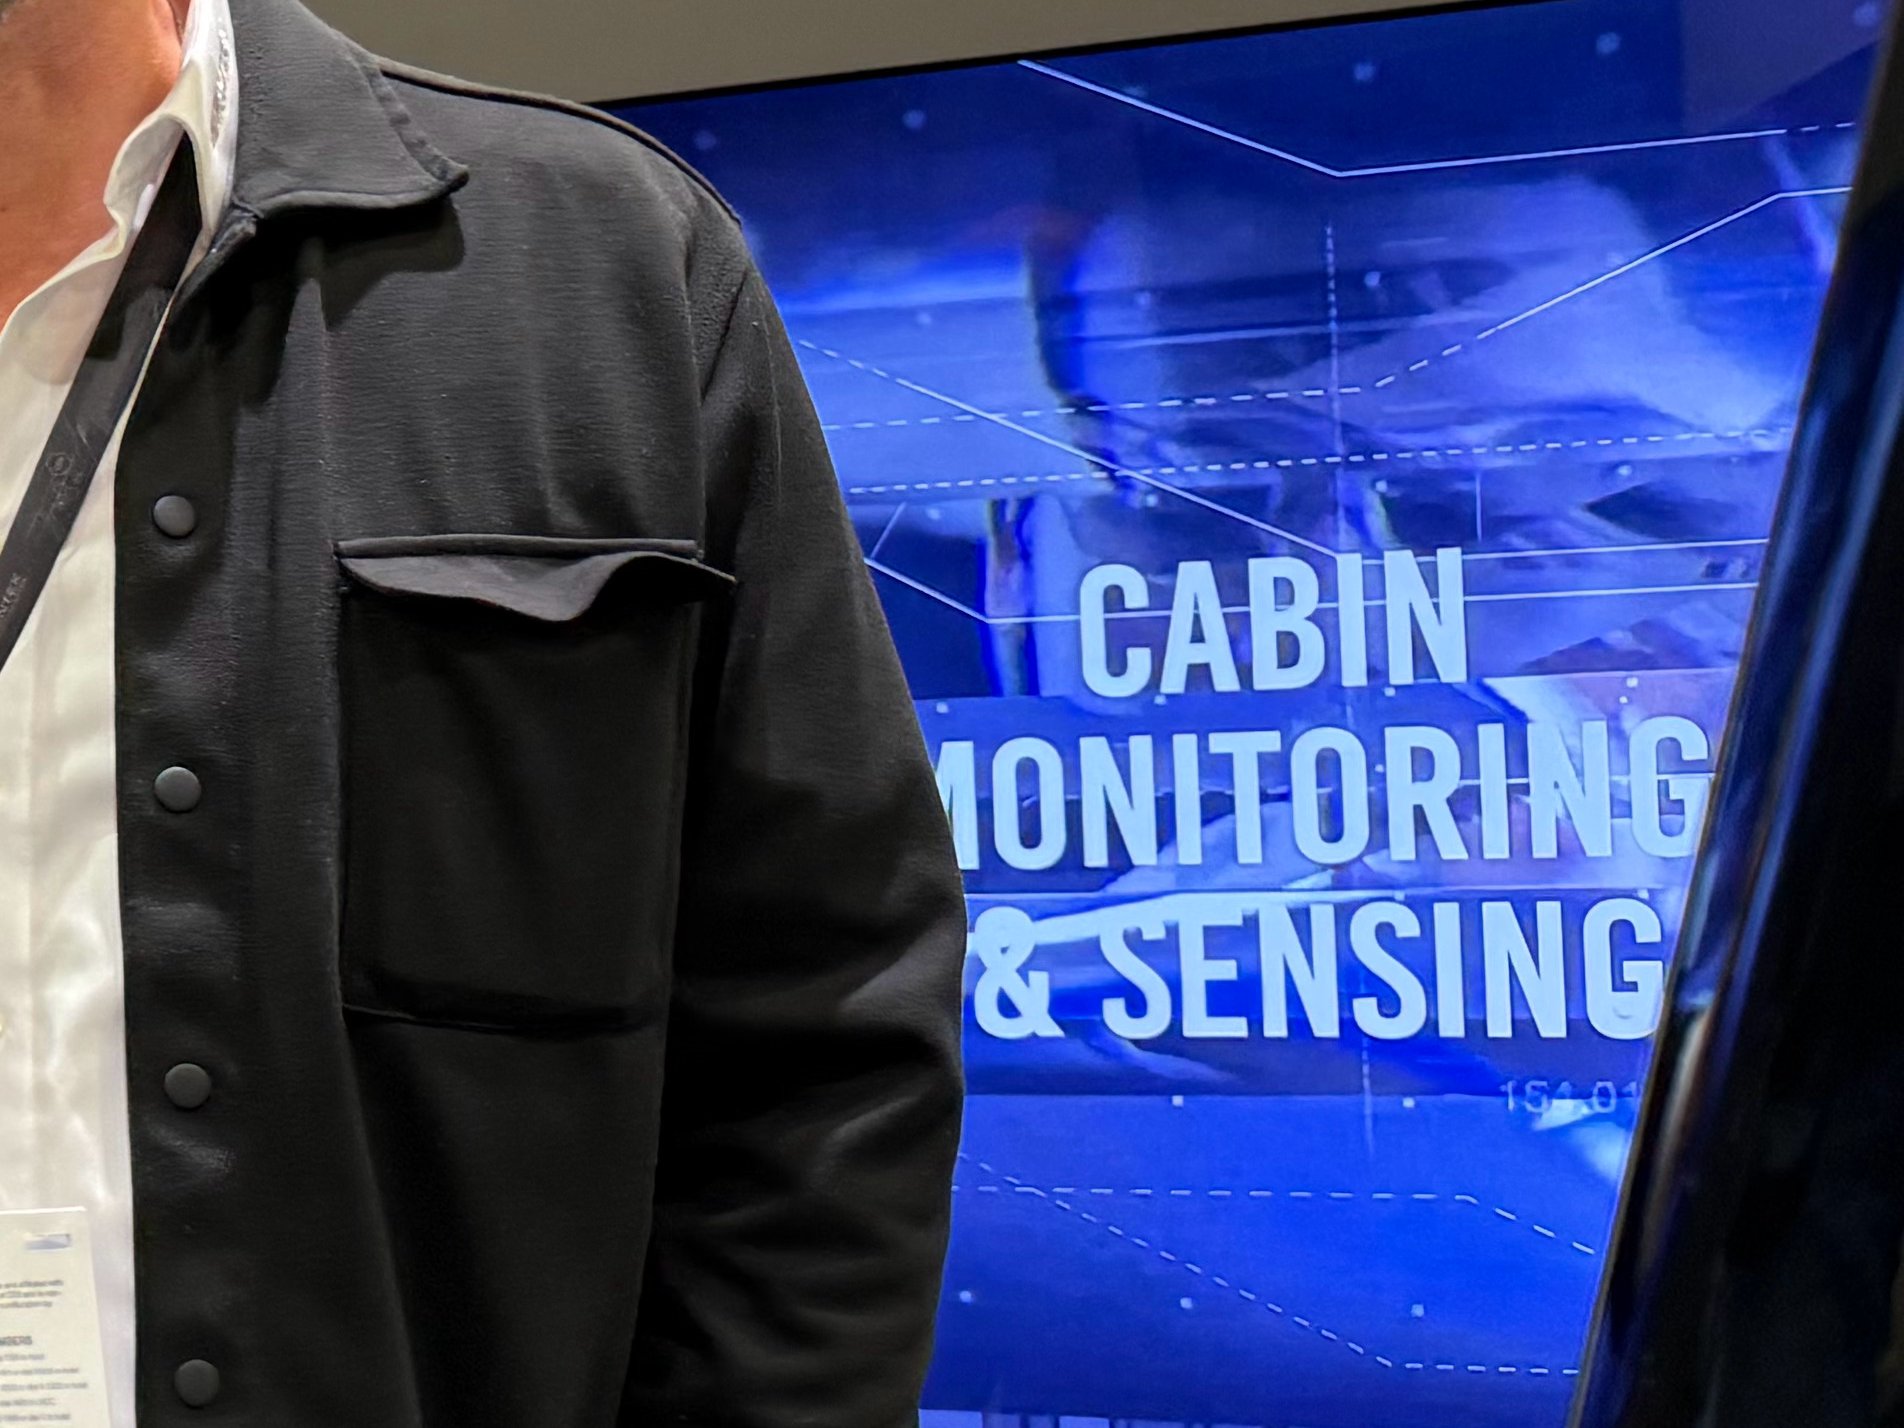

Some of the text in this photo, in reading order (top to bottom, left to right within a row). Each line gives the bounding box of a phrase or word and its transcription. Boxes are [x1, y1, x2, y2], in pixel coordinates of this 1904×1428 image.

[1079, 547, 1468, 698] CABIN
[972, 897, 1664, 1041] & SENSING
